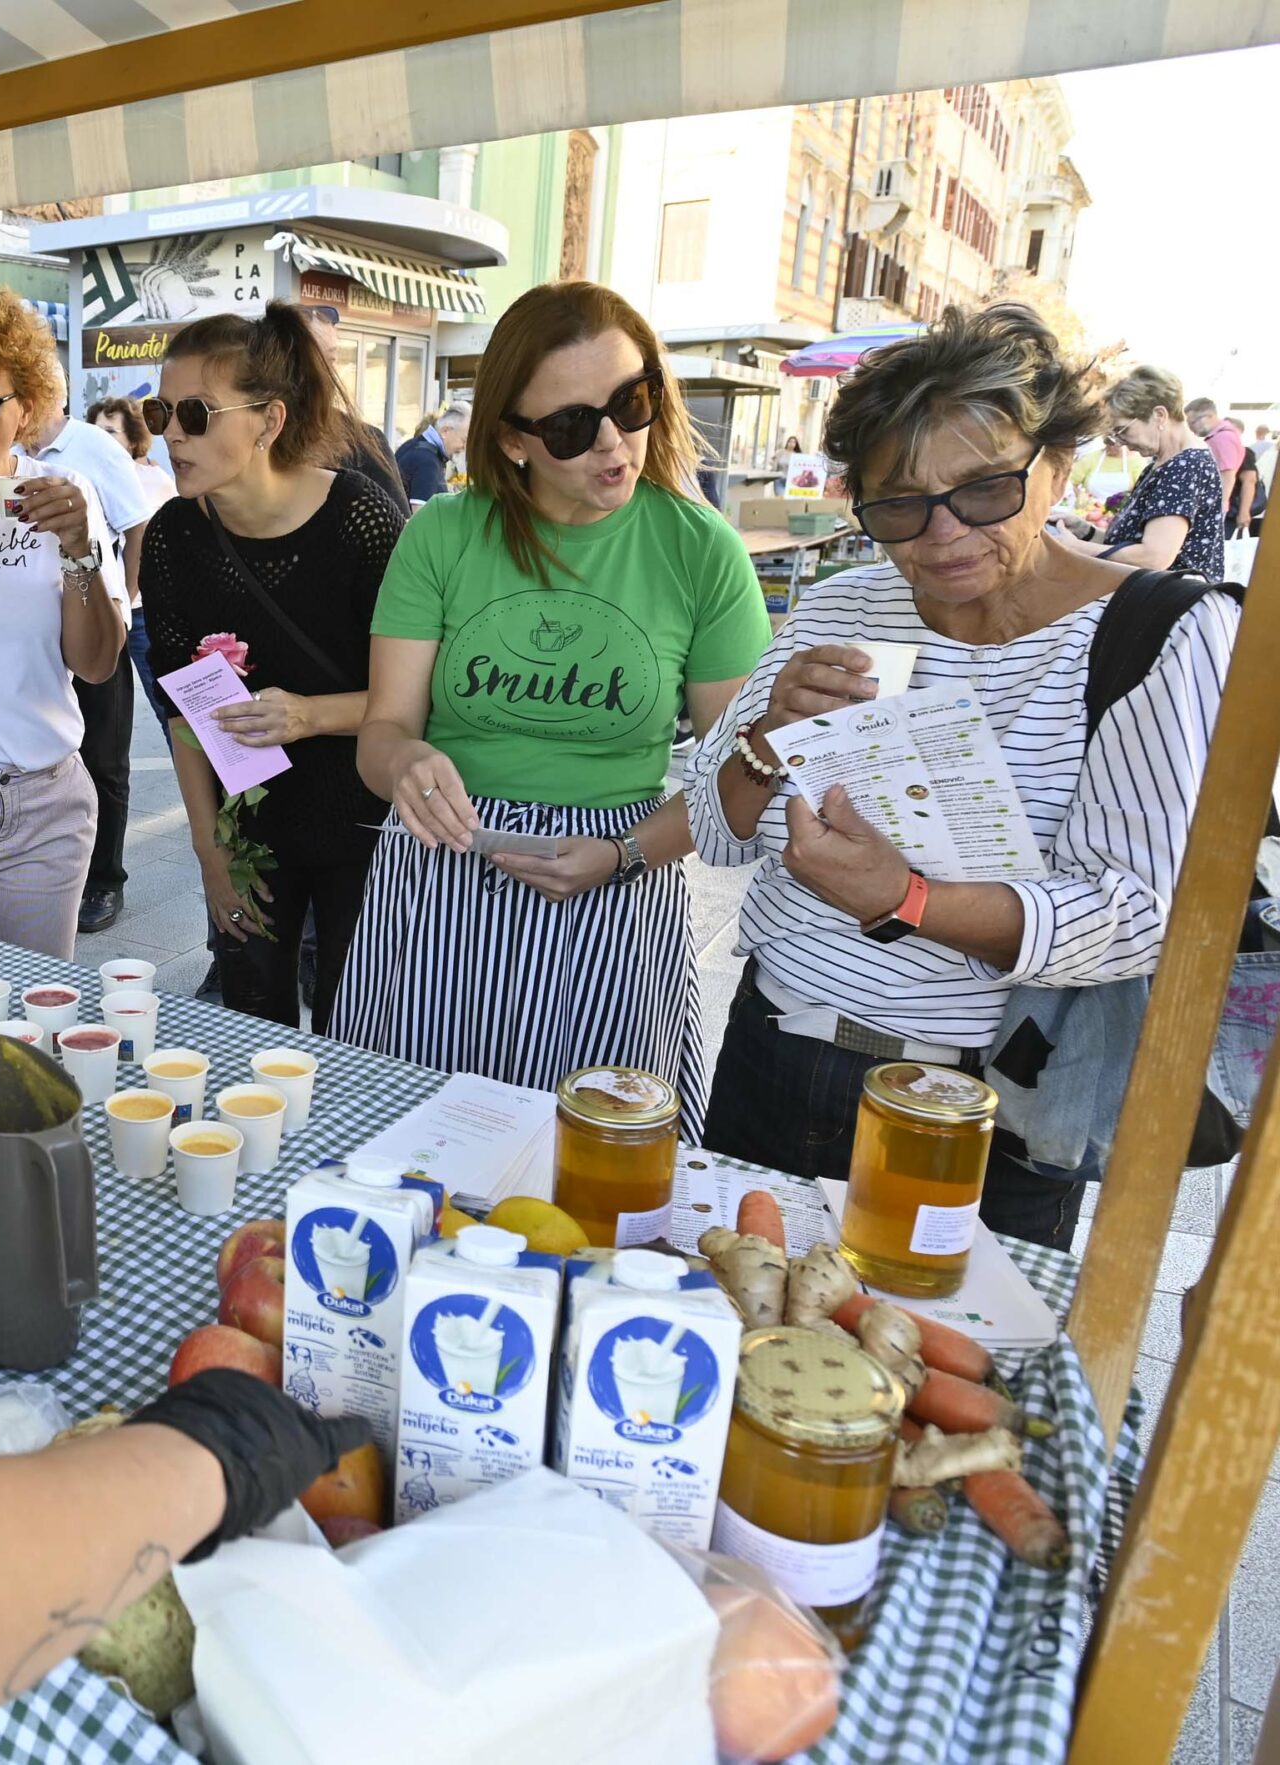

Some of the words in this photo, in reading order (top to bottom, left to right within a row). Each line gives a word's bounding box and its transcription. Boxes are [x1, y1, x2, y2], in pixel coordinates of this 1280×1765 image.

[301, 283, 321, 299] ALPE
[322, 287, 346, 304] ADRIA
[351, 286, 390, 312] PEKARA
[454, 655, 645, 716] Smutek
[323, 1295, 365, 1314] Dukat
[287, 1316, 335, 1335] mlijeko
[445, 1390, 495, 1410] Dukat
[402, 1417, 459, 1435] mlijeko
[621, 1423, 674, 1441] Dukat
[574, 1453, 634, 1470] mlijeko
